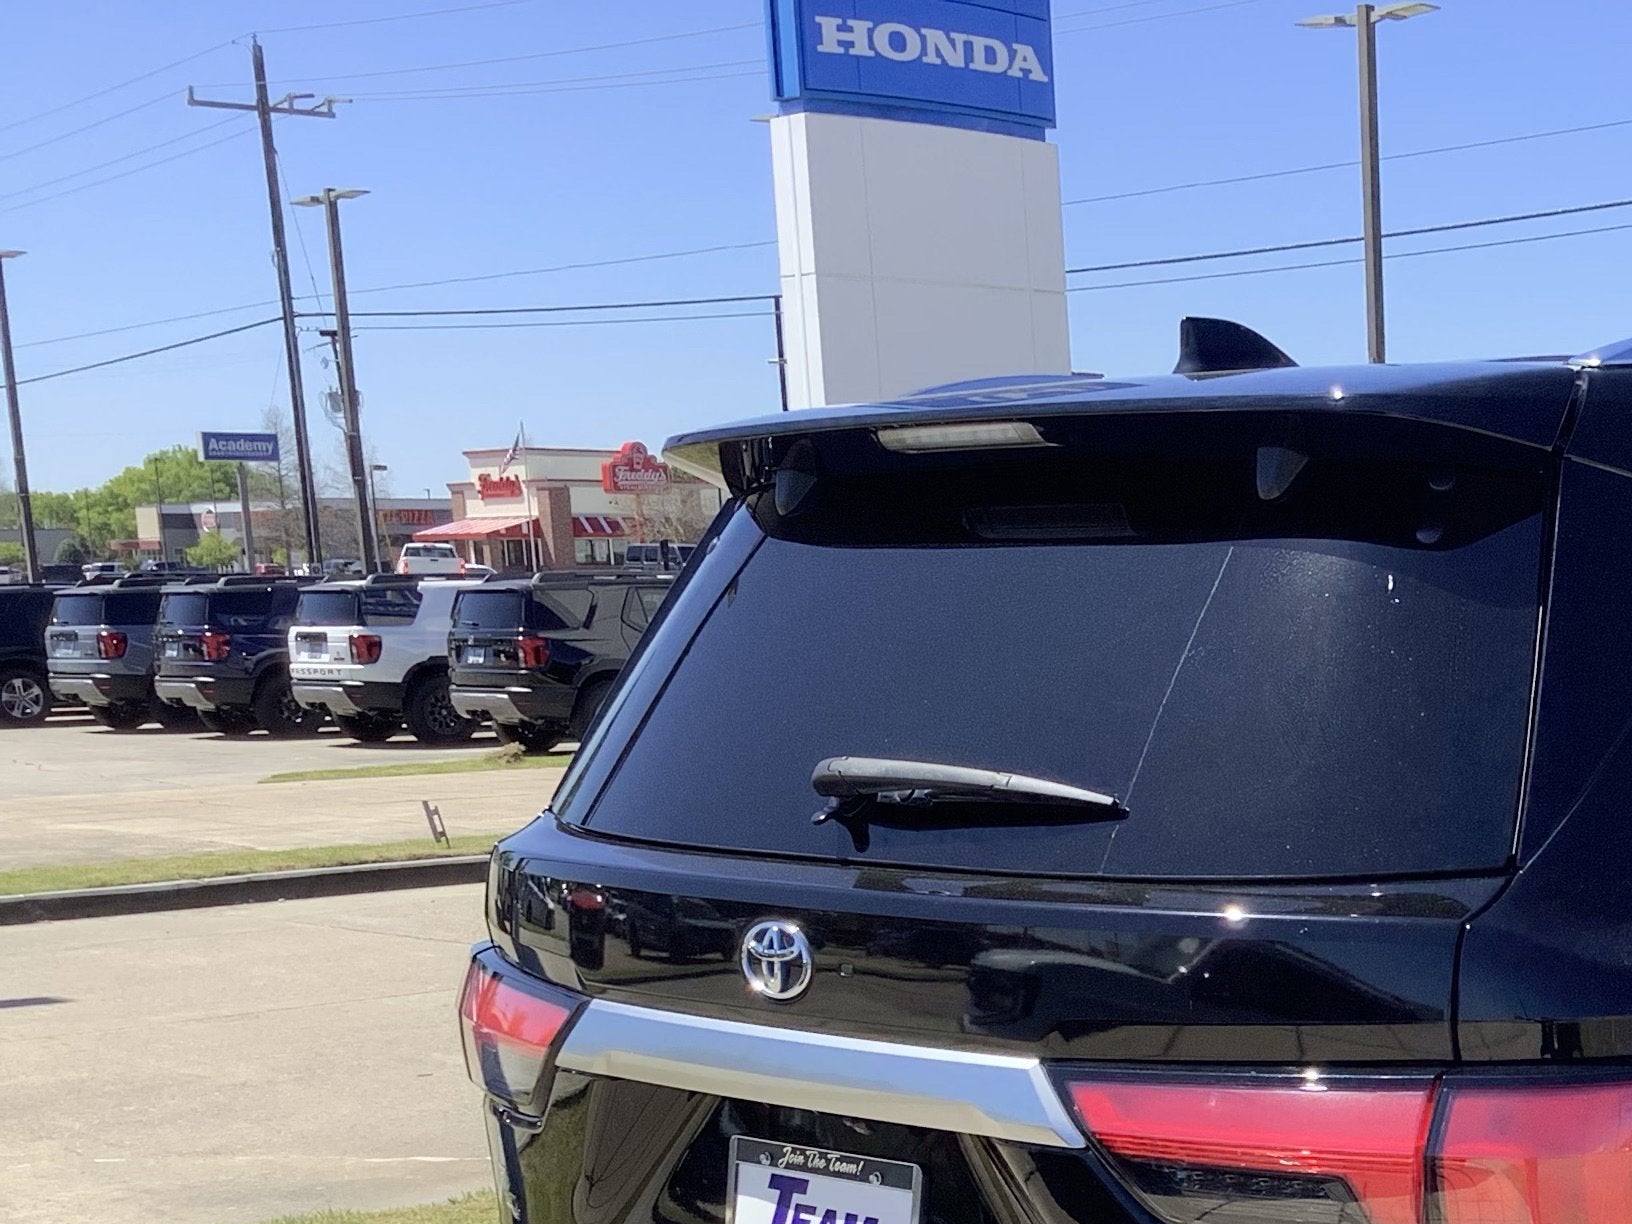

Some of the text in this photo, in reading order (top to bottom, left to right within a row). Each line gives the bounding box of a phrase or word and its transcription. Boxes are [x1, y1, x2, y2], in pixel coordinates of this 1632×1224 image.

[814, 15, 1049, 83] HONDA
[208, 438, 273, 454] Academy
[613, 466, 667, 484] Freddy's
[291, 668, 341, 676] PASSPORT
[778, 1146, 864, 1175] Join The Team!
